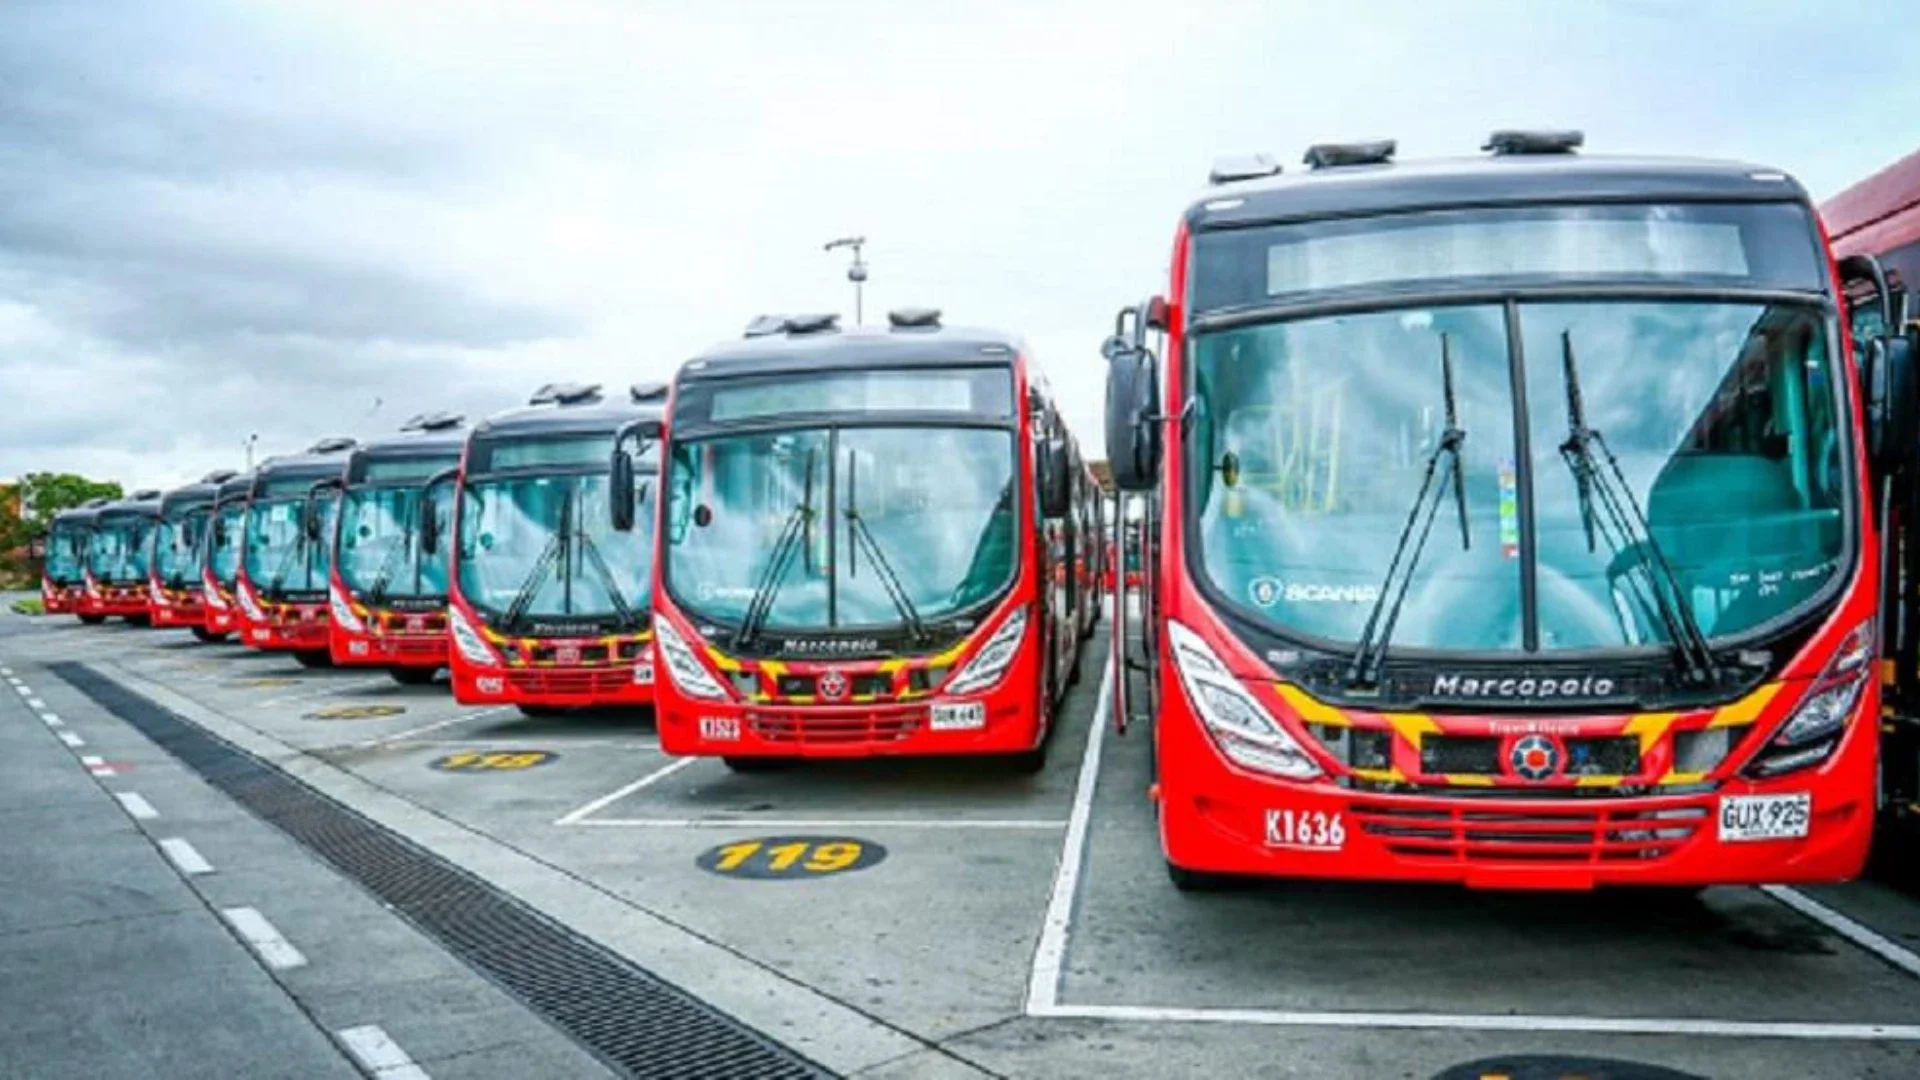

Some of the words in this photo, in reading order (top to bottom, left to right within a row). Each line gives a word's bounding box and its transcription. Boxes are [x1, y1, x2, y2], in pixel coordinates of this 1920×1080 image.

[1284, 583, 1378, 602] SCANIA
[1432, 674, 1615, 697] Marcopolo
[1265, 808, 1346, 846] K1636
[714, 842, 862, 873] 119
